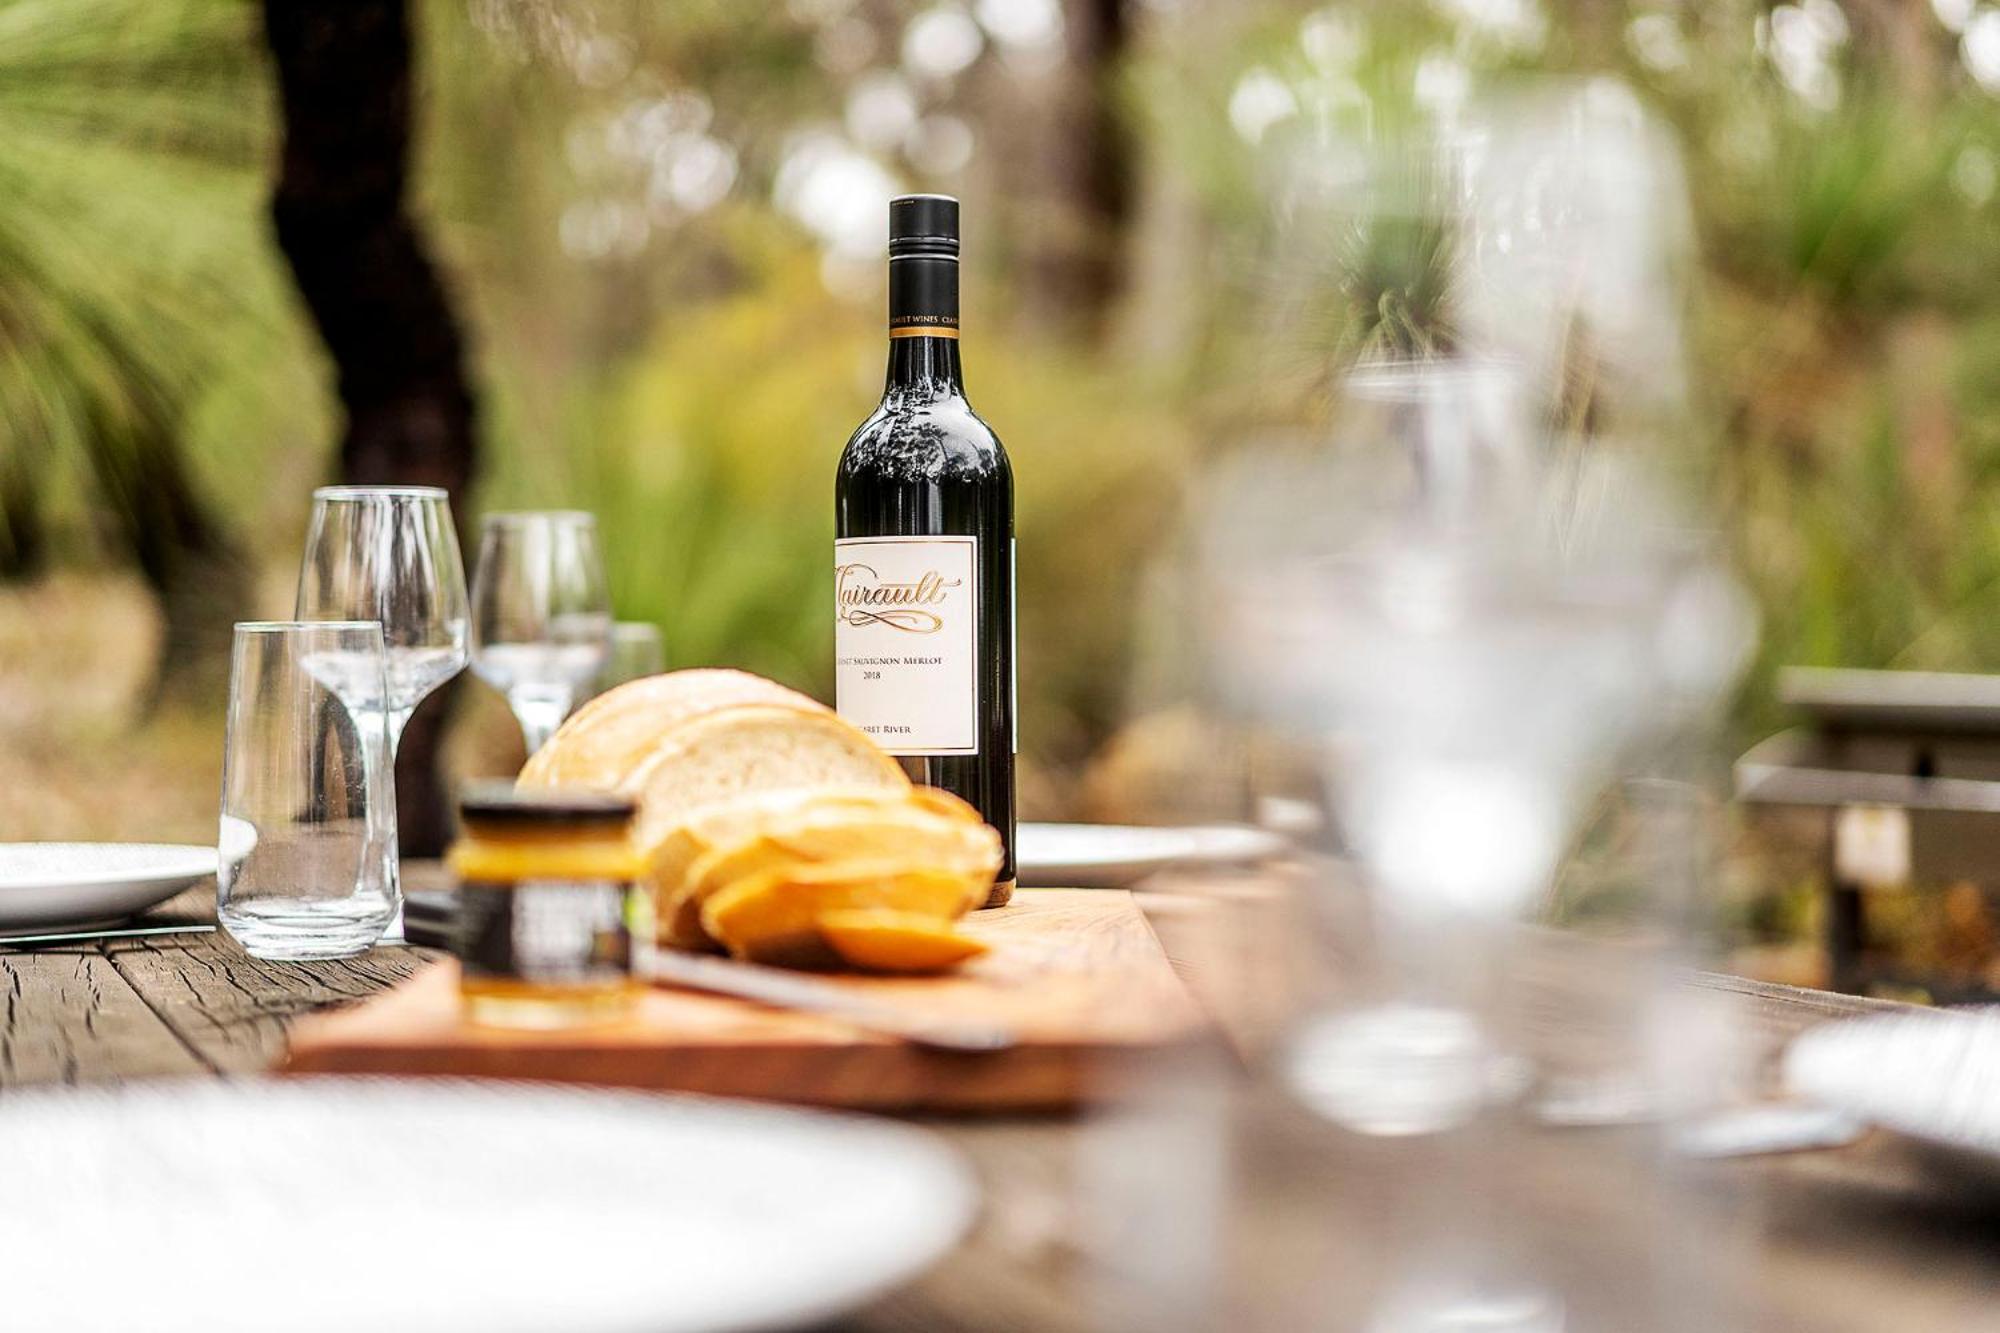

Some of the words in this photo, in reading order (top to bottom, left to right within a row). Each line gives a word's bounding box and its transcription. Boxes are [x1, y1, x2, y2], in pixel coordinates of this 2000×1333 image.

[911, 315, 938, 323] WINES
[903, 657, 942, 665] MERLOT
[863, 671, 881, 680] 2018
[883, 725, 911, 733] RIVER
